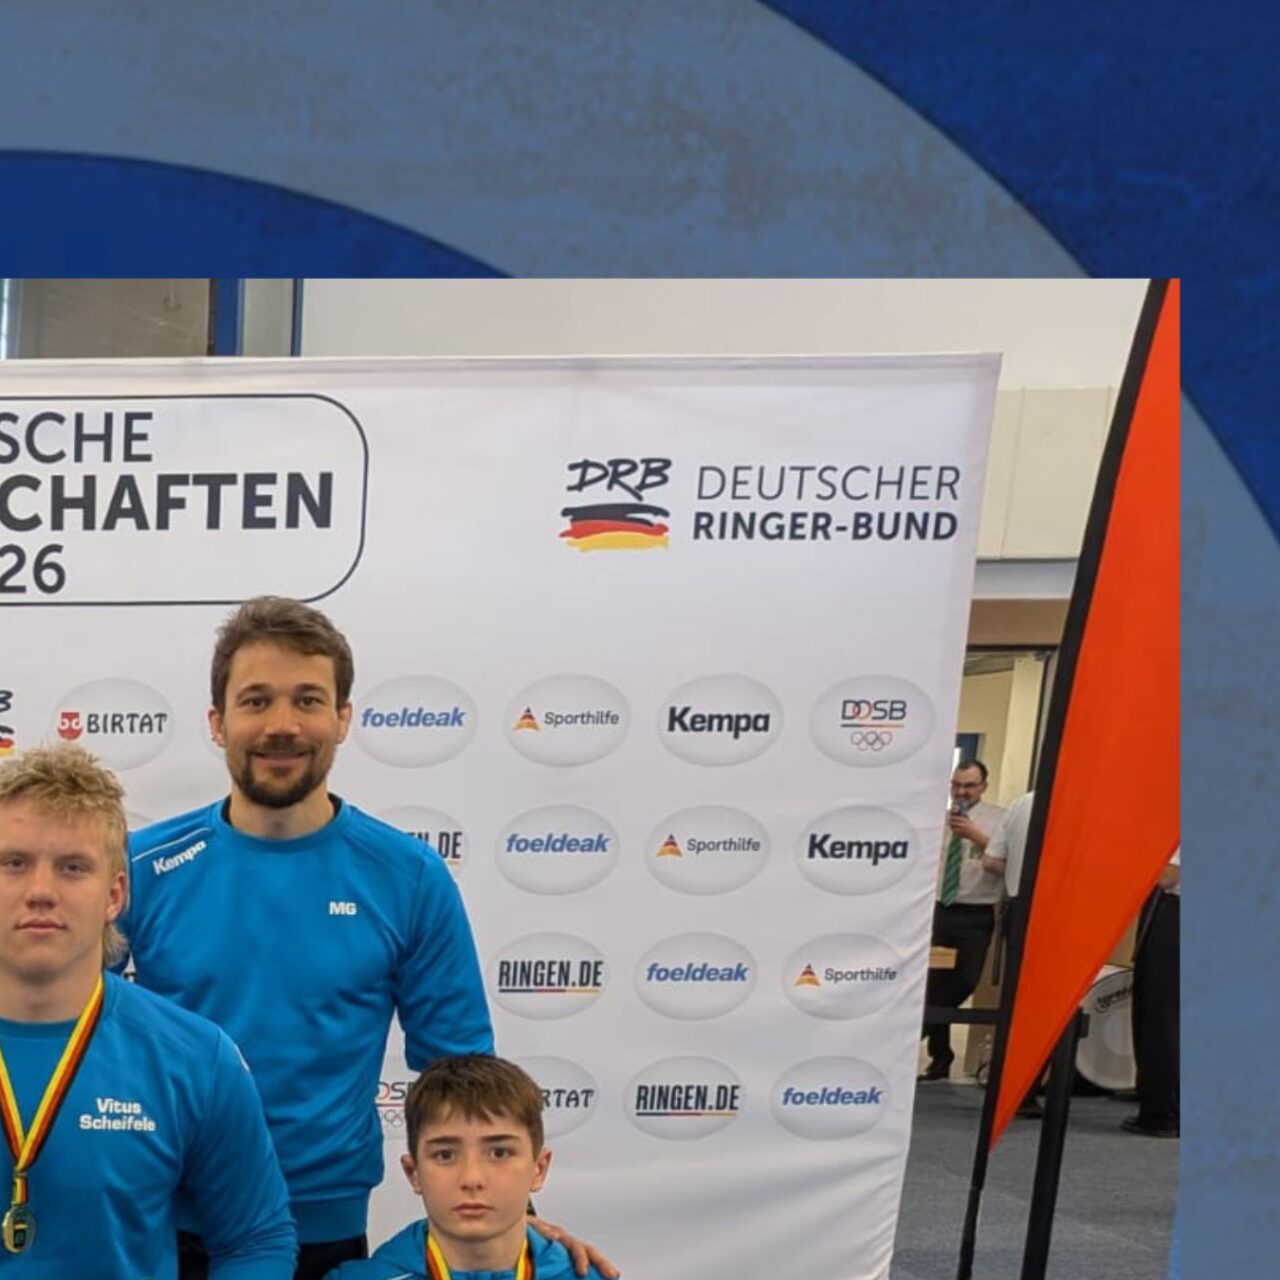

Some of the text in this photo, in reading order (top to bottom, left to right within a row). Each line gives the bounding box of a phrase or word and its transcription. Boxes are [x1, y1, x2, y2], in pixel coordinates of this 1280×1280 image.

[567, 458, 672, 501] DRB
[698, 466, 960, 500] DEUTSCHER
[694, 512, 957, 540] RINGER-BUND
[362, 707, 465, 727] foeldeak
[545, 711, 619, 727] Sporthilfe
[842, 700, 907, 720] DOSB
[87, 713, 167, 733] BIRTAT
[668, 707, 770, 739] Kempa
[507, 834, 610, 852] foeldeak
[687, 838, 760, 854] Sporthilfe
[808, 834, 908, 866] Kempa
[153, 840, 206, 875] Kempa
[330, 902, 356, 915] MG
[499, 961, 603, 986] RINGEN.DE
[647, 963, 748, 981] foeldeak
[825, 968, 898, 983] Sporthilfe
[97, 1098, 141, 1114] Vitus
[636, 1085, 739, 1110] RINGEN.DE
[783, 1087, 882, 1105] foeldeak
[80, 1112, 155, 1131] Scheifele
